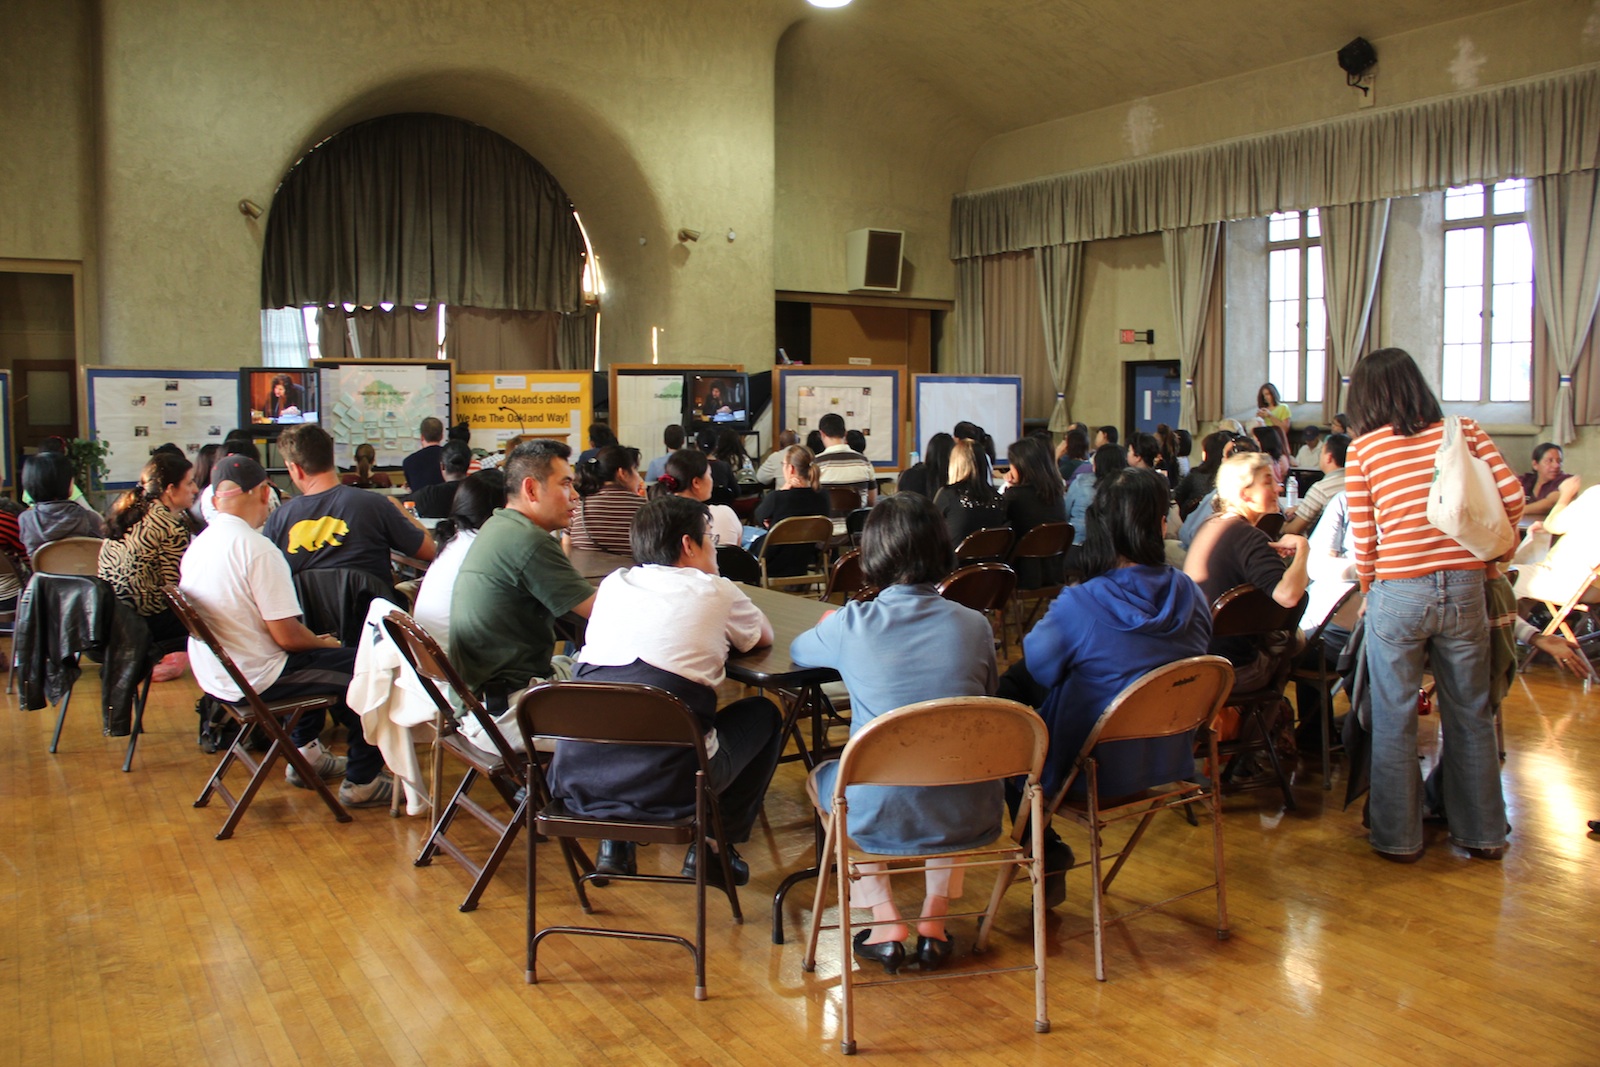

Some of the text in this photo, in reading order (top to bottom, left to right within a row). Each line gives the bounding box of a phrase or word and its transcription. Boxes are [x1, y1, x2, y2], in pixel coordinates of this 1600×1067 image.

[462, 395, 485, 405] Work
[487, 394, 499, 405] for
[545, 394, 581, 405] children
[456, 412, 569, 424] We Are The Oakland Way!
